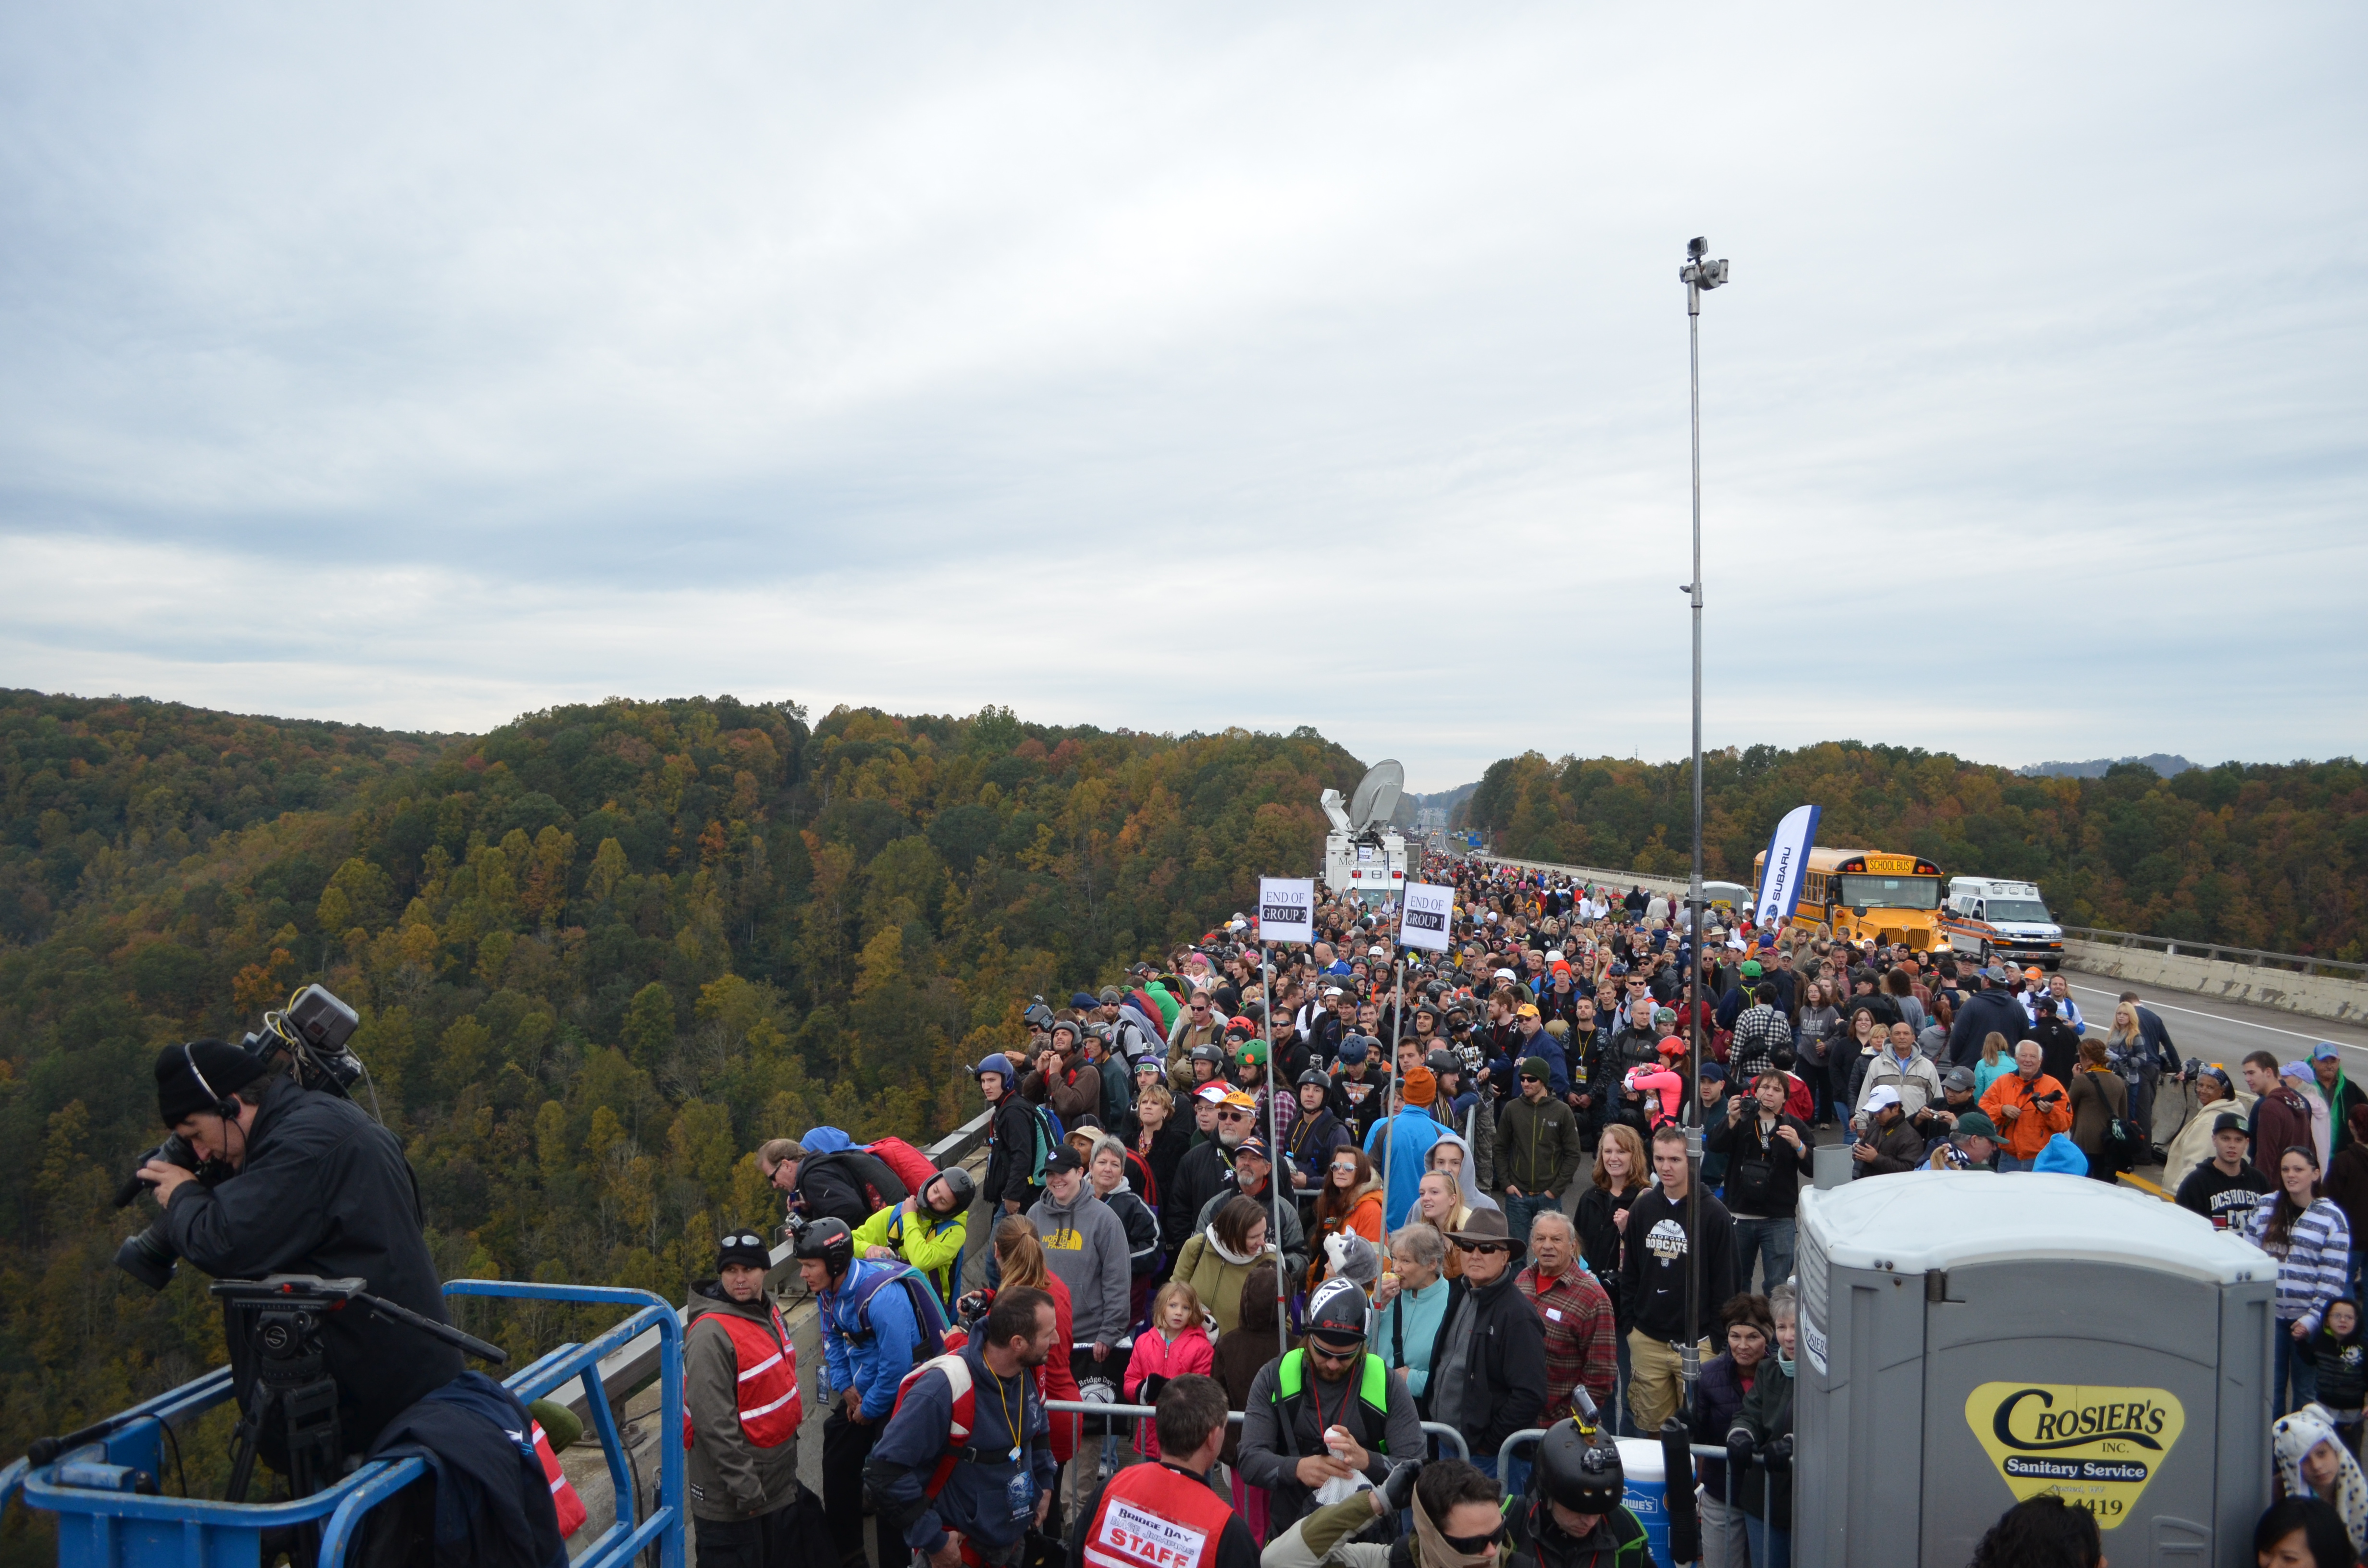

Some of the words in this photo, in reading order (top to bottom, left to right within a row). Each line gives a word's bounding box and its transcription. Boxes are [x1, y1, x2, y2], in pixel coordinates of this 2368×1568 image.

[1869, 860, 1896, 870] SCHOOL
[1897, 861, 1910, 871] BUS
[1773, 847, 1791, 901] SUBARU
[1266, 891, 1288, 903] END
[1291, 892, 1305, 904] OF
[1410, 895, 1429, 908] END
[1431, 899, 1444, 911] OF
[1262, 907, 1299, 921] GROUP
[1301, 910, 1306, 921] 2
[1406, 912, 1437, 928] GROUP
[1439, 917, 1443, 929] 1
[1645, 1237, 1687, 1254] BOBCATS
[1647, 1234, 1687, 1243] RADFORD
[1078, 1375, 1101, 1387] Bridge
[1993, 1388, 2166, 1450] CROSIER'S
[2102, 1442, 2129, 1453] INC.
[2007, 1458, 2078, 1478] Sanitary
[2084, 1462, 2145, 1478] Service
[1622, 1497, 1653, 1511] OWE'S
[1118, 1507, 1161, 1531] BRIDGE
[1164, 1526, 1192, 1542] DAY
[1110, 1516, 1141, 1535] BASE
[1142, 1530, 1195, 1556] JUMPING
[1110, 1527, 1189, 1568] STAFF
